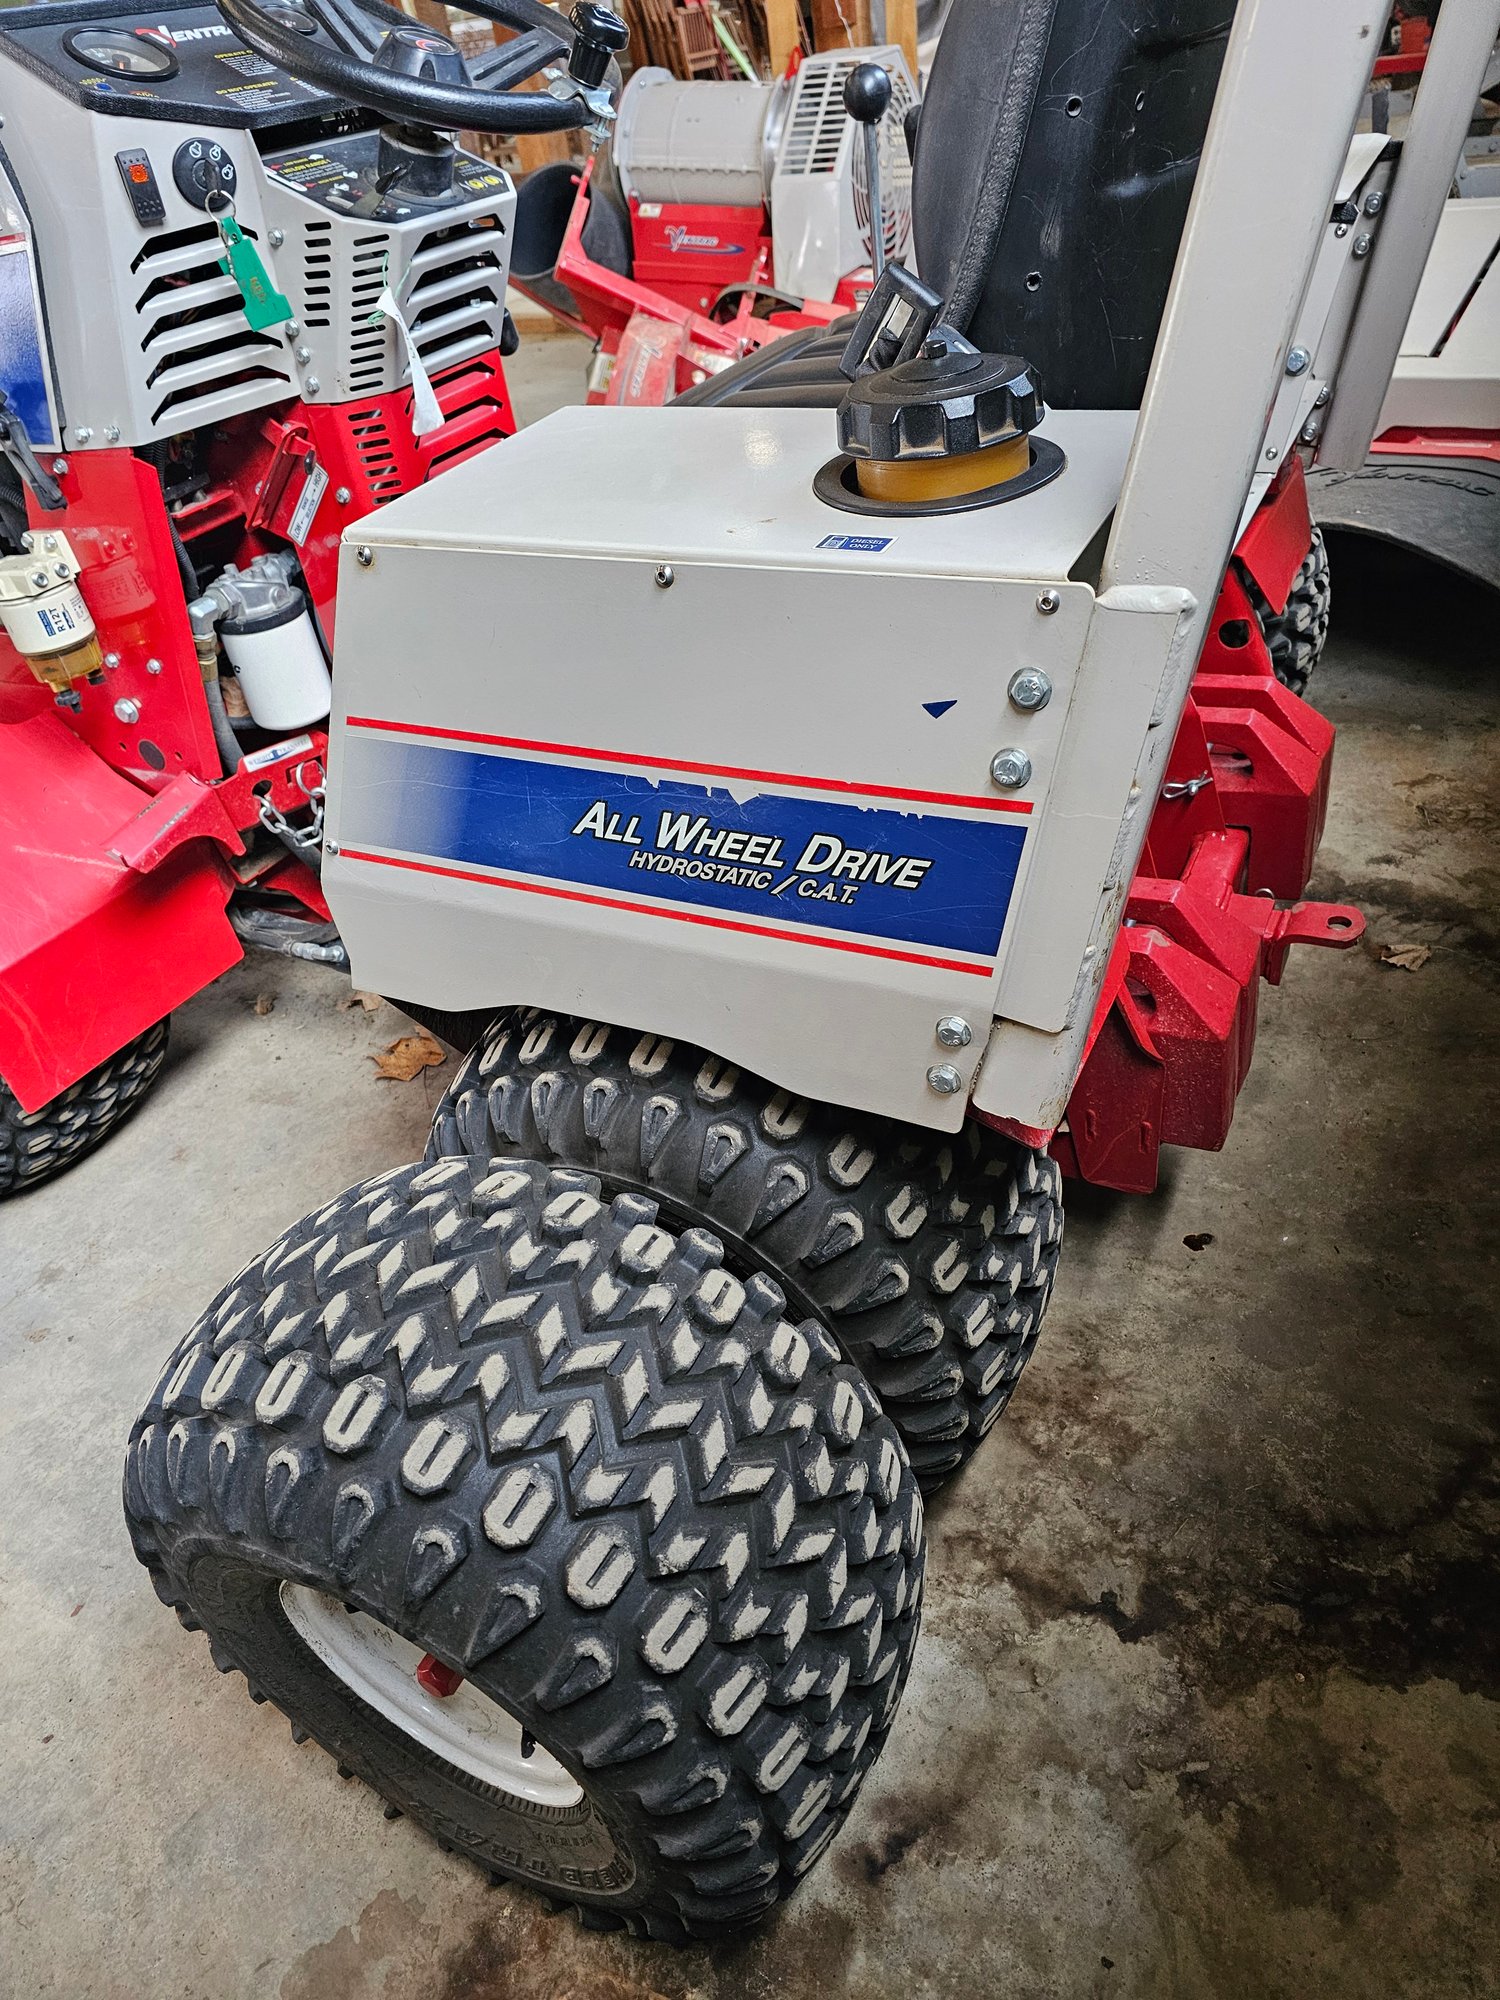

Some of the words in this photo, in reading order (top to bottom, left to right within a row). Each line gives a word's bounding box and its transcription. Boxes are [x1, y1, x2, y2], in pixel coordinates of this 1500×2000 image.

[47, 608, 67, 633] R12T
[573, 800, 643, 845] ALL
[655, 811, 786, 868] WHEEL
[796, 833, 935, 891] DRIVE
[628, 850, 774, 891] HYDROSTATIC
[797, 878, 859, 905] C.A.T.
